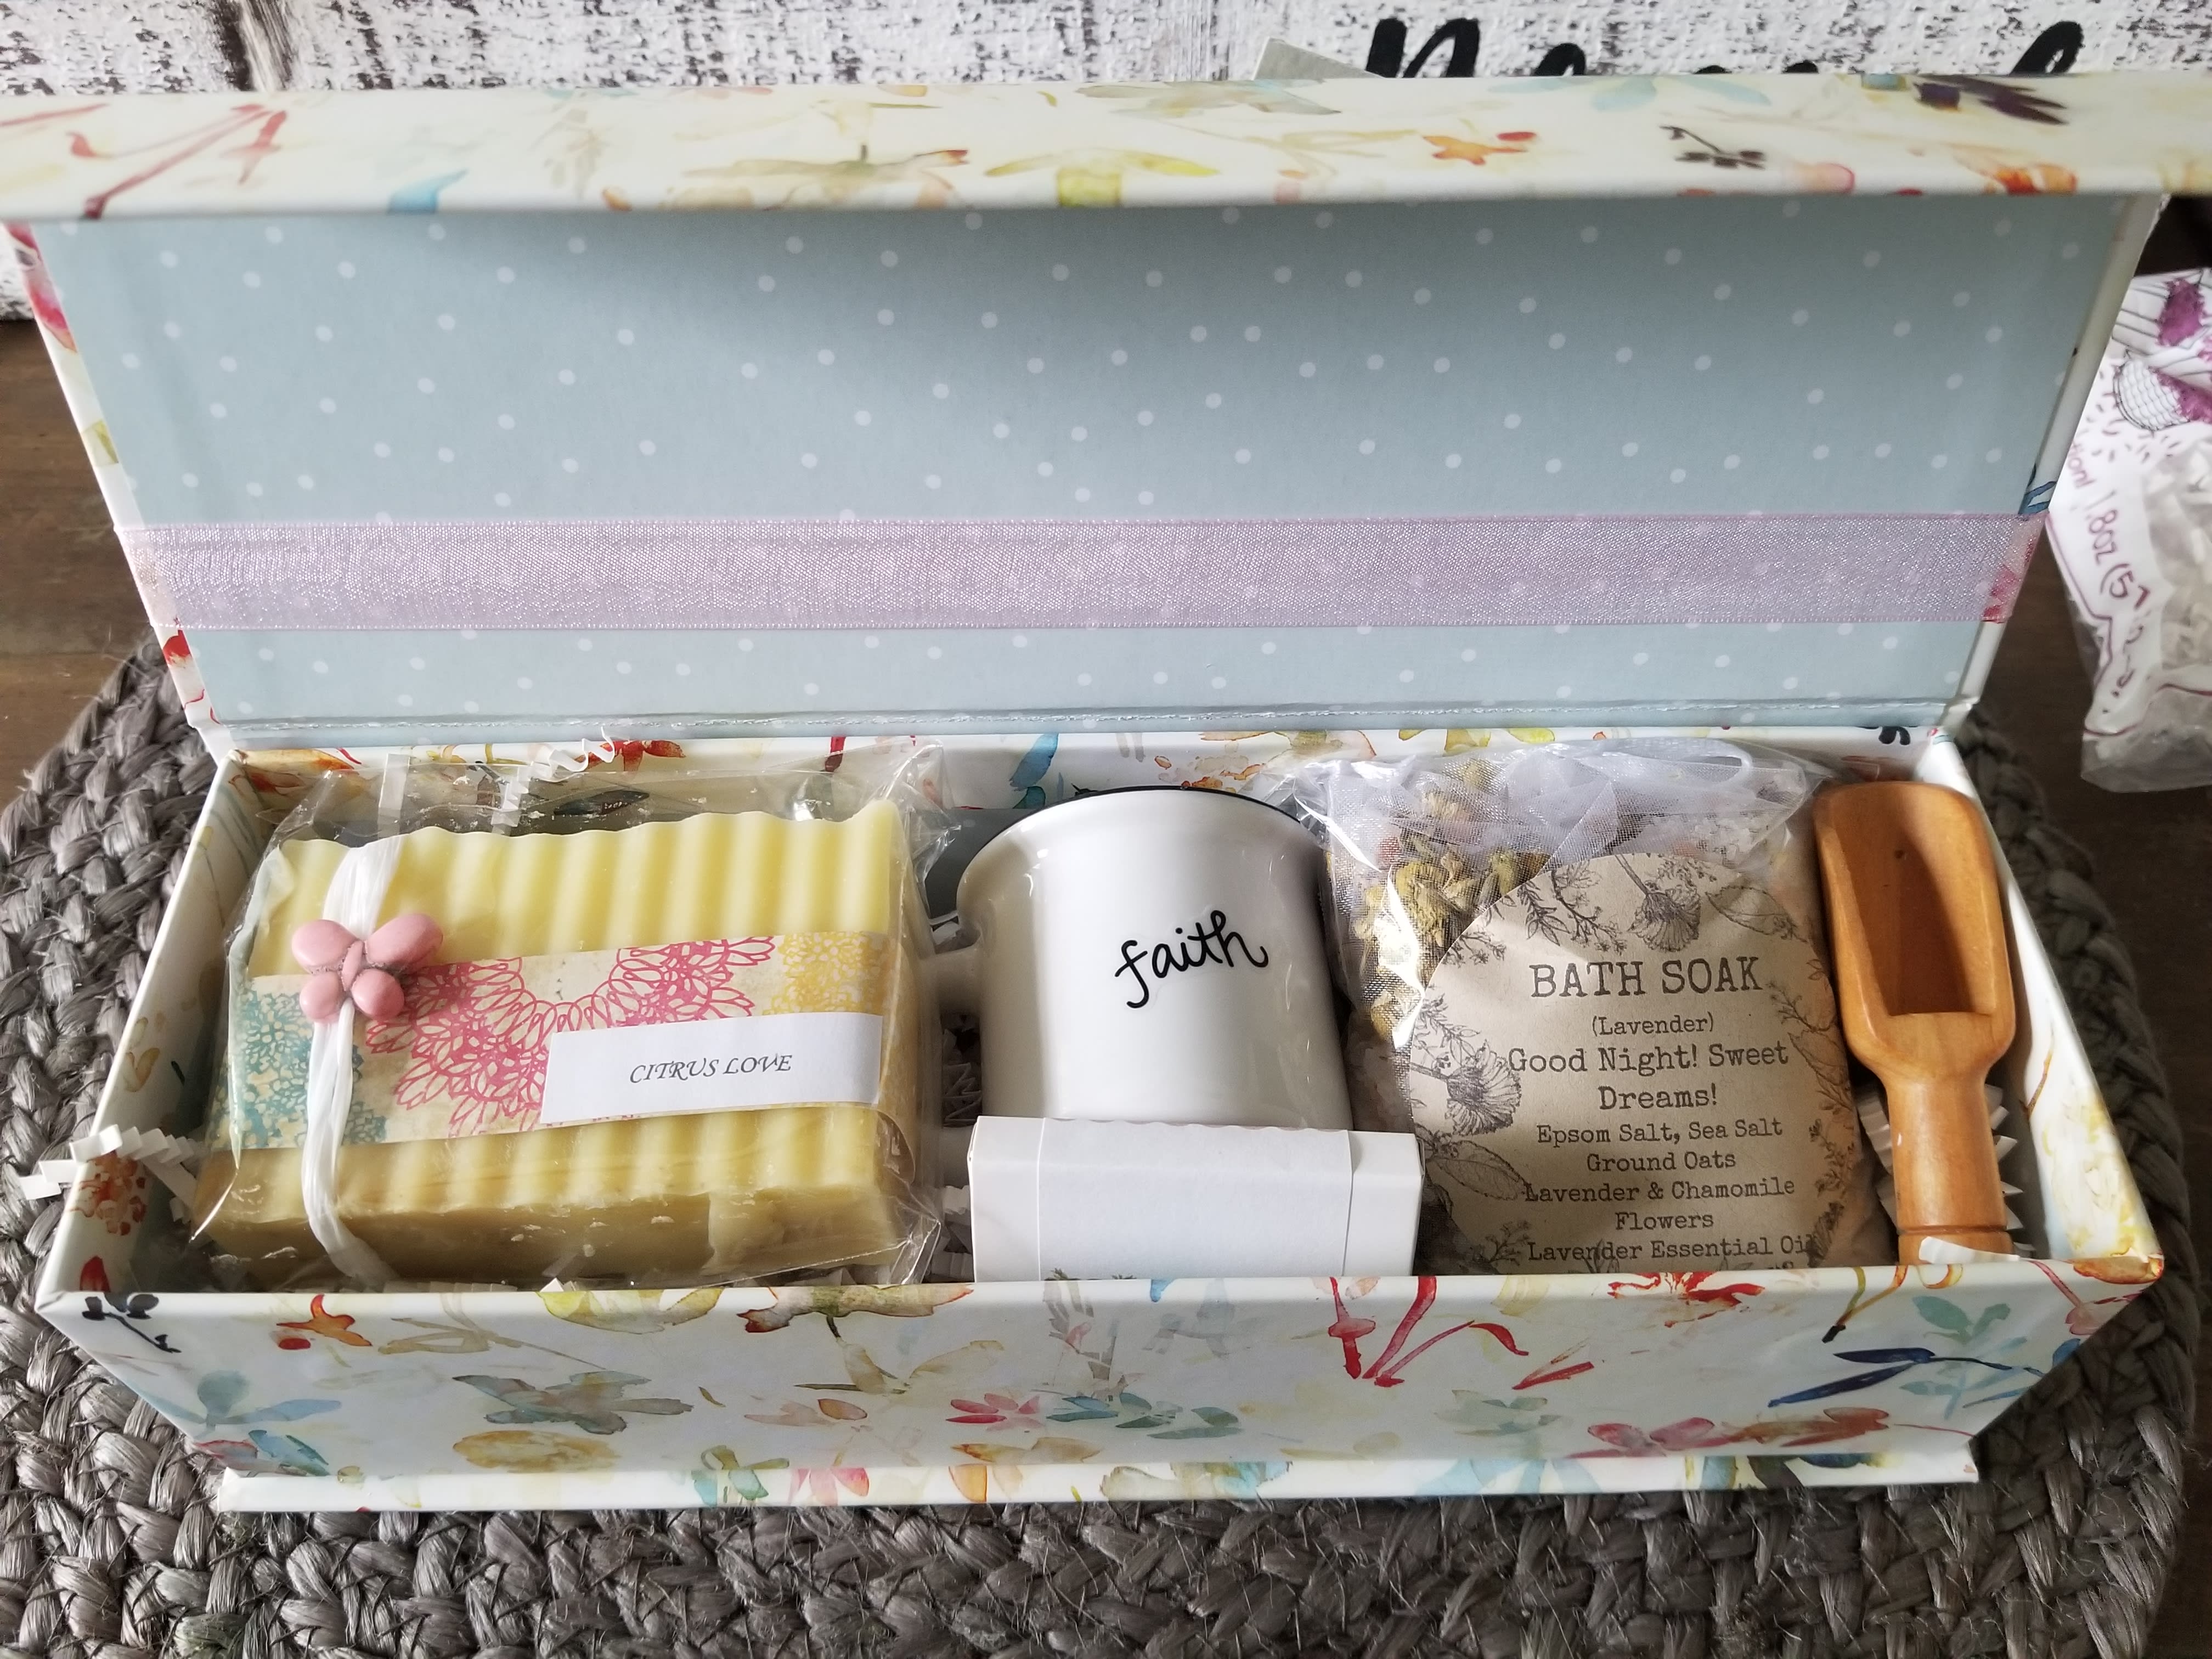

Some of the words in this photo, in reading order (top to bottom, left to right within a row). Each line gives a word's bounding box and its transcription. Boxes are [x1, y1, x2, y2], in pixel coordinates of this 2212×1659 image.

[1114, 910, 1269, 1008] faith
[1529, 961, 1646, 998] BATH
[1661, 956, 1763, 994] SOAK
[1592, 1012, 1714, 1037] (Lavender)
[630, 1058, 719, 1084] CITRUS
[723, 1053, 793, 1075] LOVE
[1508, 1047, 1588, 1073] Good
[1598, 1043, 1698, 1077] Night!
[1708, 1041, 1789, 1068] Sweet
[1598, 1083, 1718, 1110] Dreams!
[1537, 1124, 1611, 1148] Epsom
[1618, 1122, 1681, 1144] Salt,
[1688, 1121, 1729, 1141] Sea
[1734, 1117, 1784, 1138] Salt
[1587, 1152, 1677, 1172] Ground
[1684, 1150, 1737, 1169] Oats
[1523, 1182, 1640, 1203] Lavender
[1647, 1182, 1664, 1199] &
[1671, 1176, 1795, 1200] Chamomile
[1615, 1211, 1714, 1231] Flowers
[1527, 1240, 1643, 1261] Lavender
[1651, 1236, 1773, 1259] Essential
